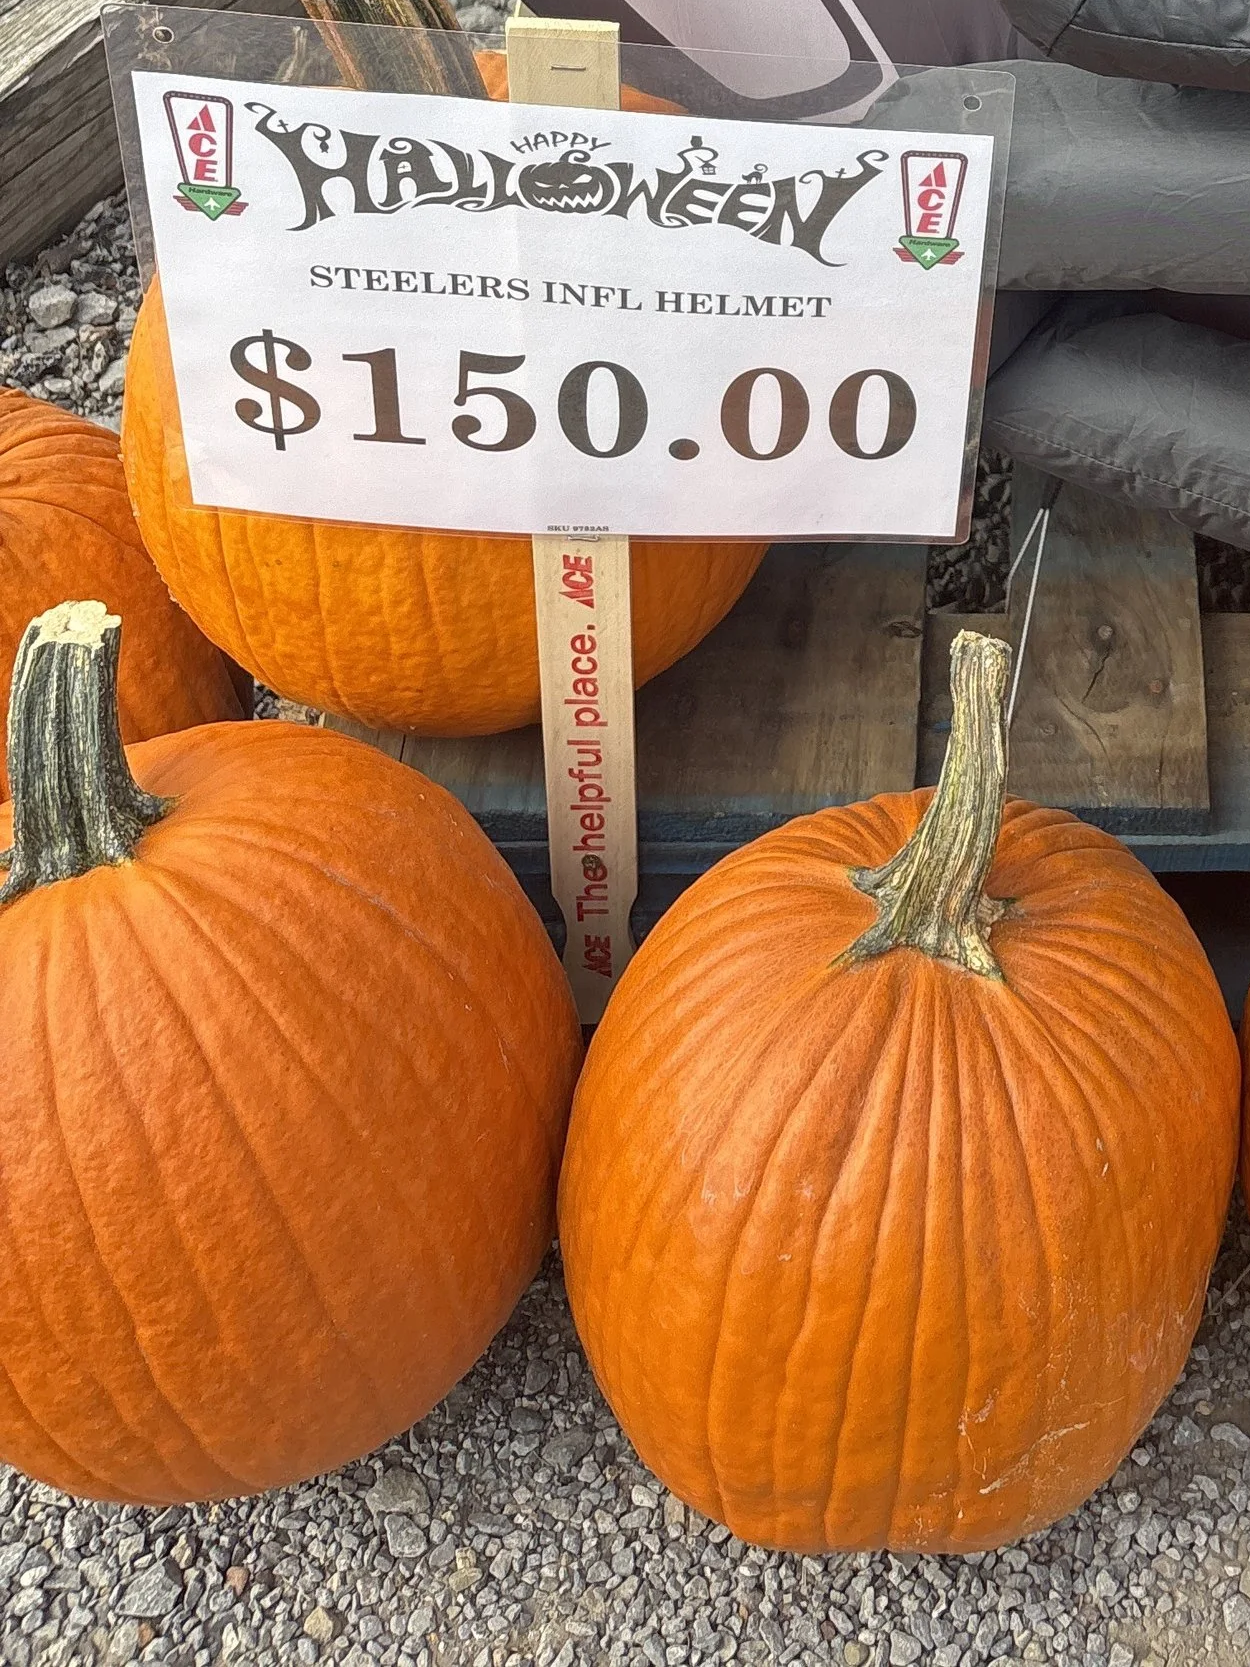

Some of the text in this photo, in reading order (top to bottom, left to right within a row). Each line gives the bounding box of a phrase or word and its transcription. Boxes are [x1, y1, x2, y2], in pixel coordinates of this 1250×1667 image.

[186, 103, 219, 183] ACE
[510, 130, 612, 154] HAPPY
[188, 186, 233, 197] Hardware
[915, 160, 948, 234] ACE
[908, 238, 952, 248] Hardware
[309, 264, 832, 319] STEELERS INFL HELMET
[229, 329, 918, 462] $150.00
[558, 555, 613, 979] ACE The helpful place. ACE
